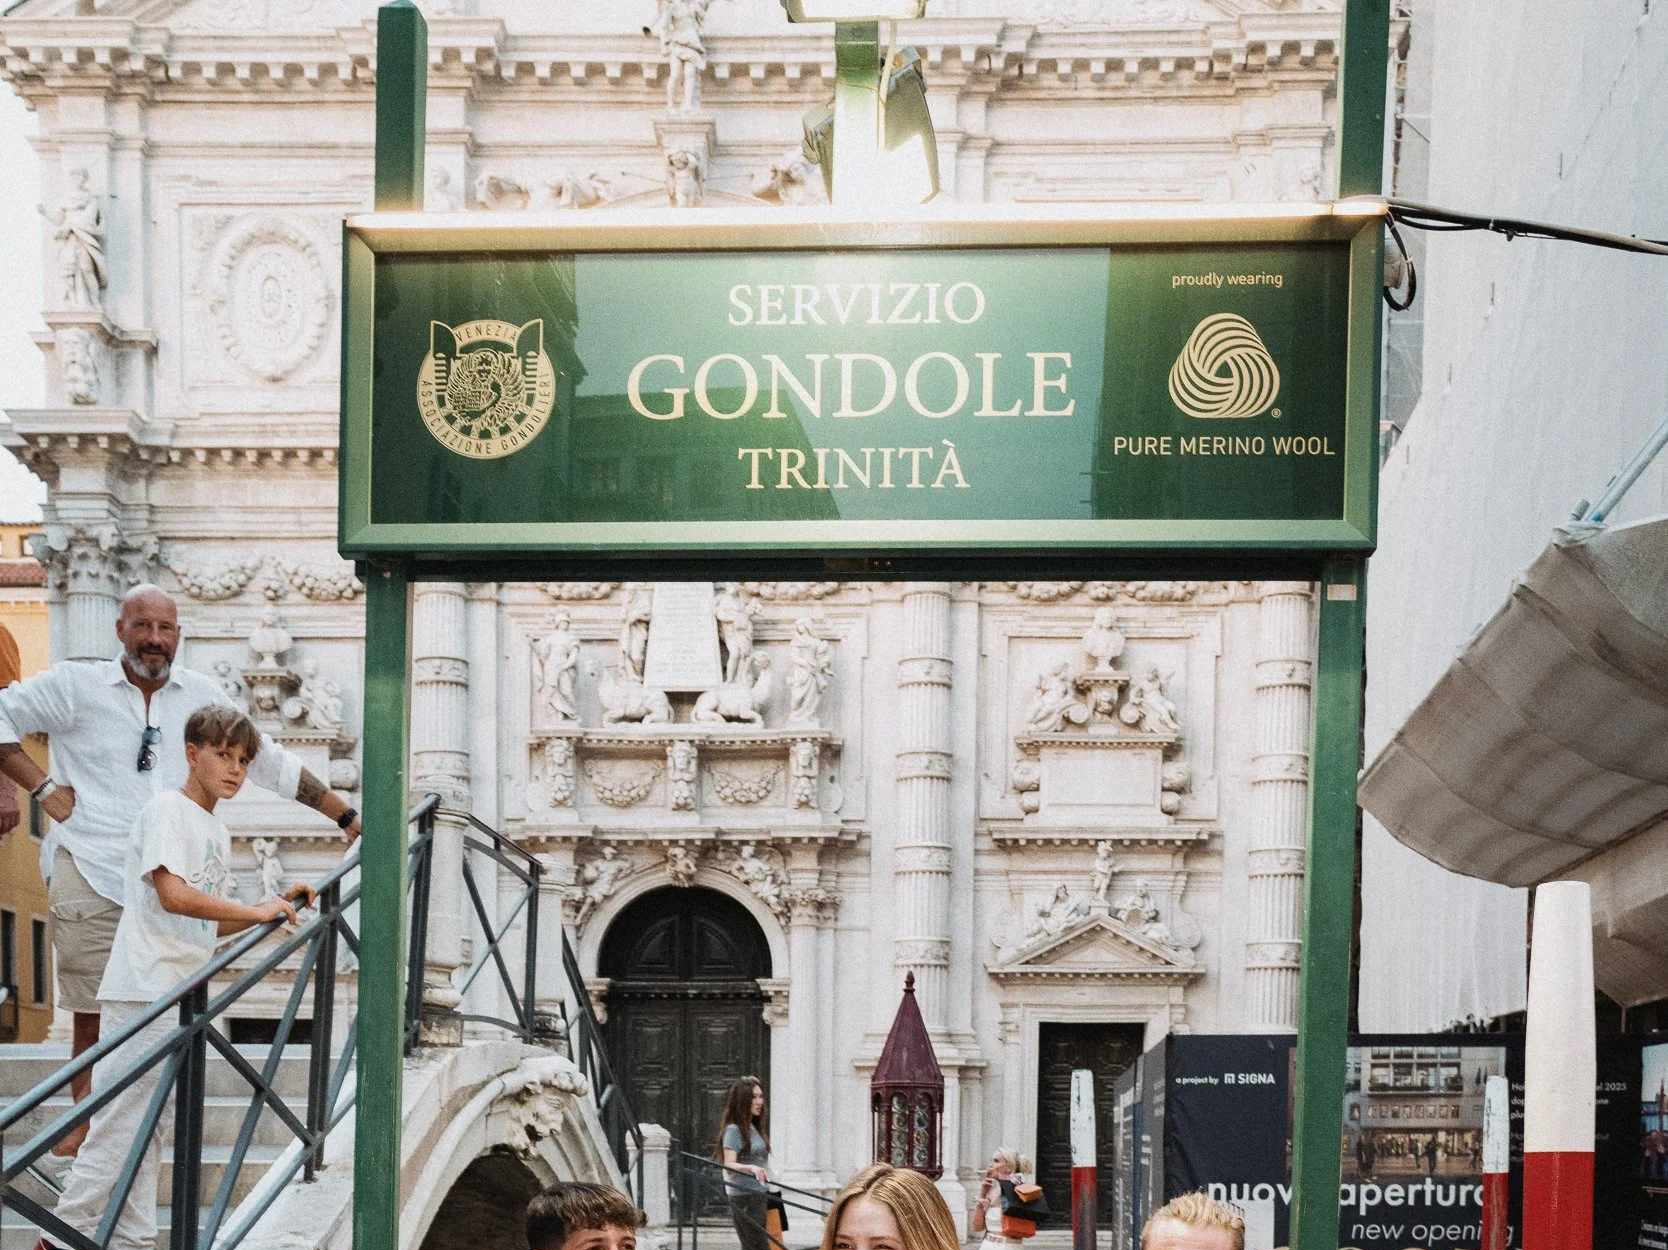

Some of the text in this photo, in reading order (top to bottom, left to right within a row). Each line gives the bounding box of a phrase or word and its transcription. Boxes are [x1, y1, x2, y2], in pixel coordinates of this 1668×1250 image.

[1172, 272, 1283, 288] proudly wearing
[728, 281, 986, 326] SERVIZIO
[455, 323, 517, 341] VENEZIA
[627, 351, 1076, 420] GONDOLE
[421, 373, 551, 455] ASSOCIAZIONE GONDOLIERI
[1114, 436, 1335, 455] PURE MERINO WOOL
[738, 438, 971, 489] TRINITÀ
[1182, 1076, 1208, 1085] project
[1208, 1076, 1219, 1085] by
[1237, 1073, 1276, 1084] SIGNA
[1208, 1182, 1293, 1206] nuov
[1351, 1220, 1513, 1248] new openig
